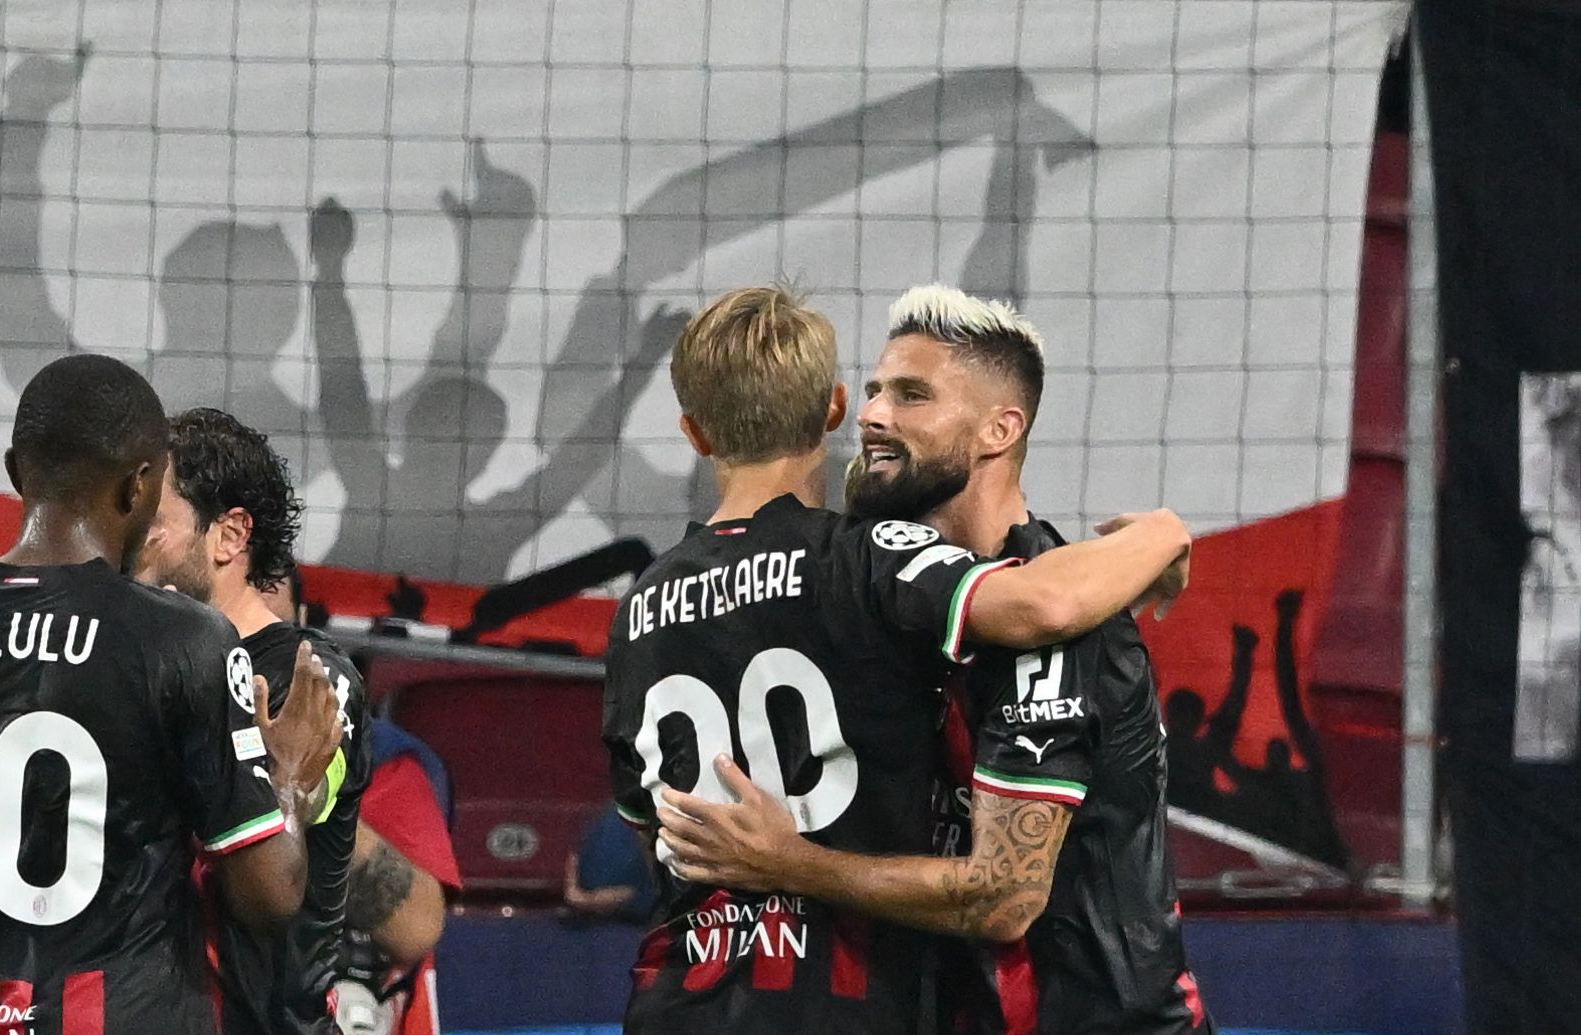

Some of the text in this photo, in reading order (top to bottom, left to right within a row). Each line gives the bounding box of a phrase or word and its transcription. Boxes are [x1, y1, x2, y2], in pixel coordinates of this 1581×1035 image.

[628, 548, 807, 642] DE KETELAERE
[1002, 696, 1085, 724] BitMEX
[685, 920, 808, 965] MILAN
